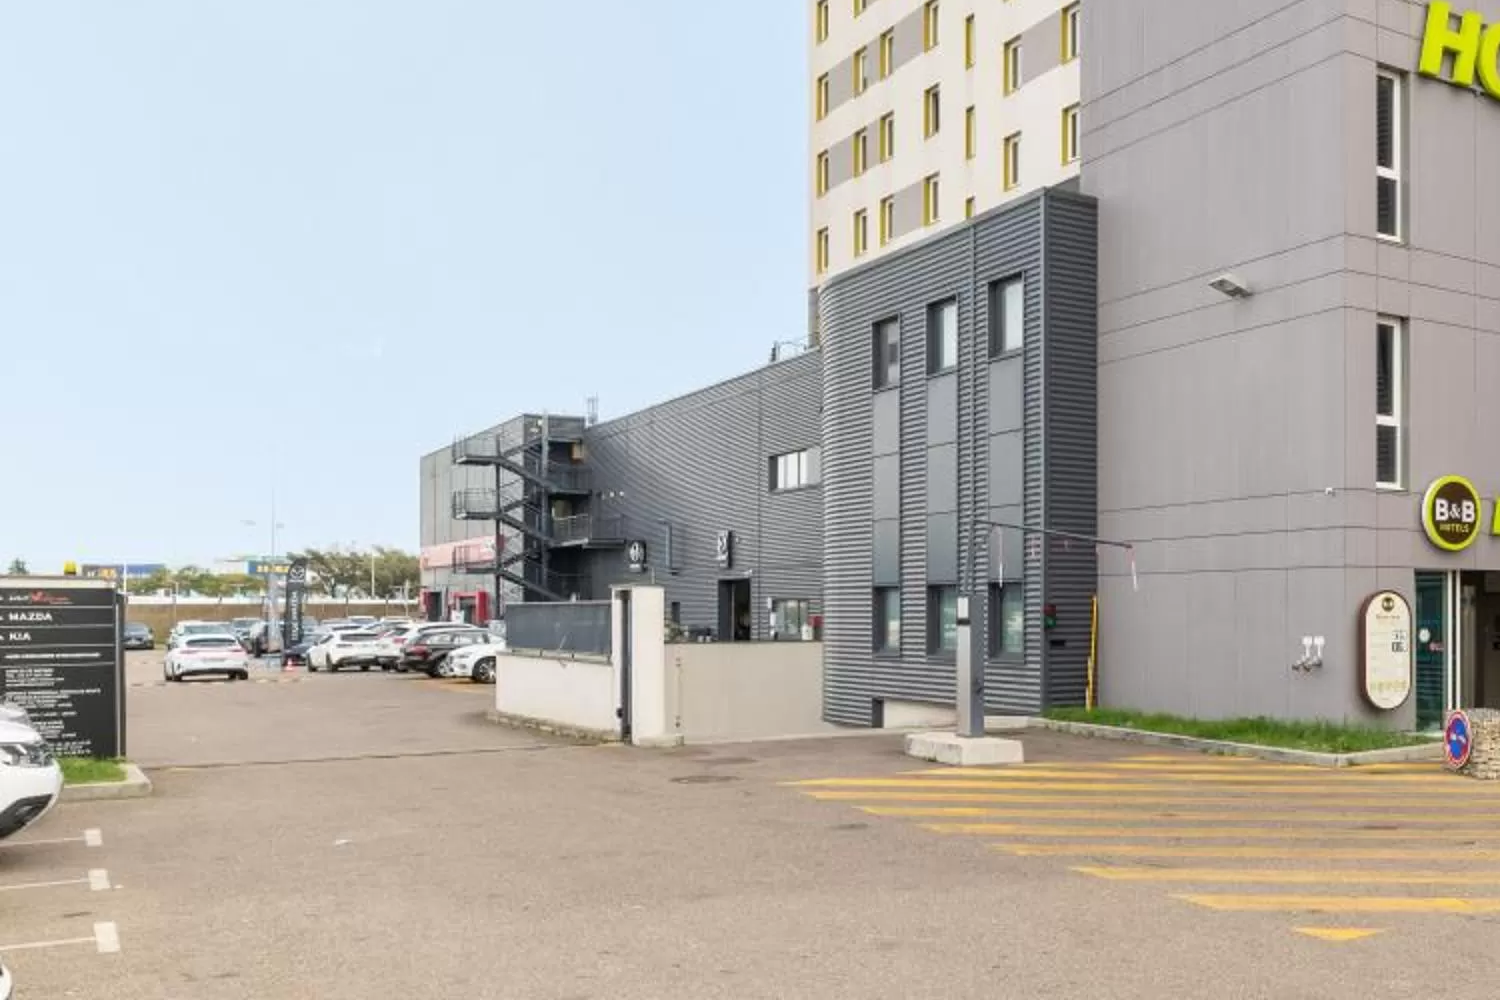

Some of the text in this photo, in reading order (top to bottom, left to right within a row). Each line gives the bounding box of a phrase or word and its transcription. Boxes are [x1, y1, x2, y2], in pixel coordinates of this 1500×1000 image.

[1435, 498, 1475, 523] B&B
[8, 612, 53, 622] MAZDA
[8, 632, 32, 641] KIA
